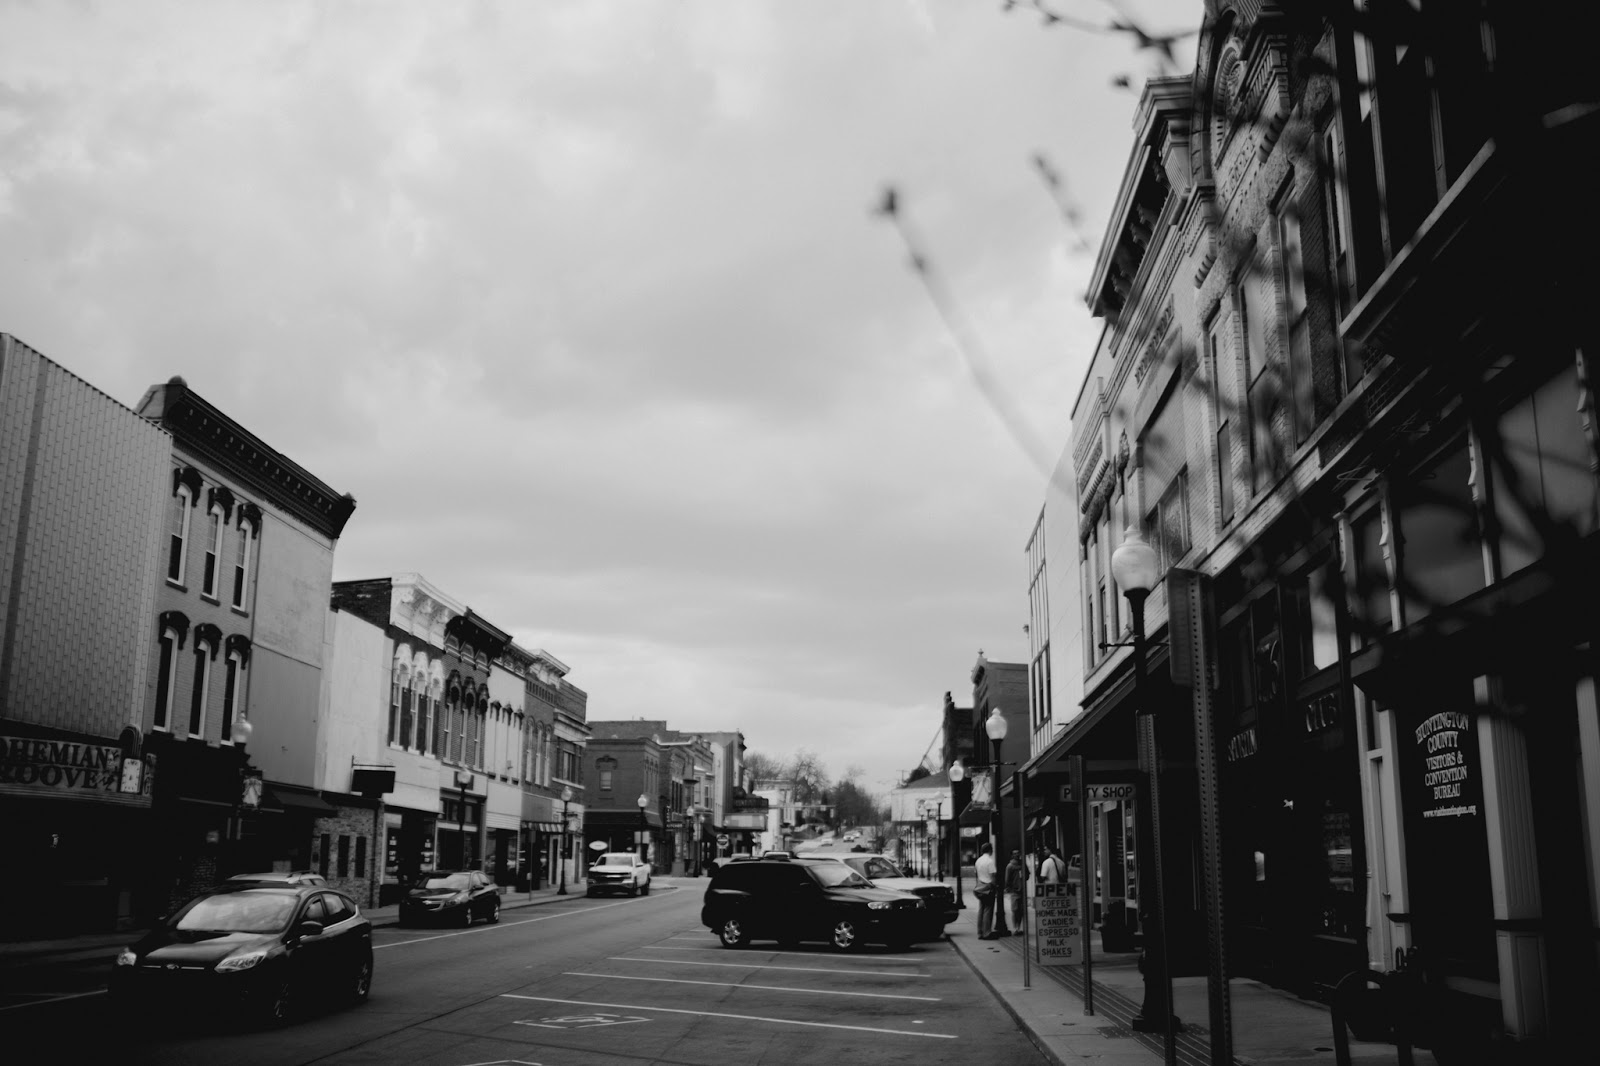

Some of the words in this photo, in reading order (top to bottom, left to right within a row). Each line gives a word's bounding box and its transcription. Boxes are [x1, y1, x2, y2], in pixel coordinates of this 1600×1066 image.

[1415, 711, 1469, 744] HUNTINGTON
[1427, 731, 1459, 753] COUNTY
[1426, 752, 1456, 770] VISITORS
[1457, 750, 1463, 764] &
[1424, 765, 1467, 786] CONVENTION
[1064, 787, 1098, 799] PTY
[1102, 786, 1133, 798] SHOP
[1433, 783, 1460, 800] BUREAU
[1035, 883, 1076, 897] OPEN
[1041, 899, 1071, 907] COFFEE
[1042, 917, 1074, 926] CANDIES
[1038, 928, 1079, 936] ESPRESSO
[1041, 947, 1072, 956] SHAKES
